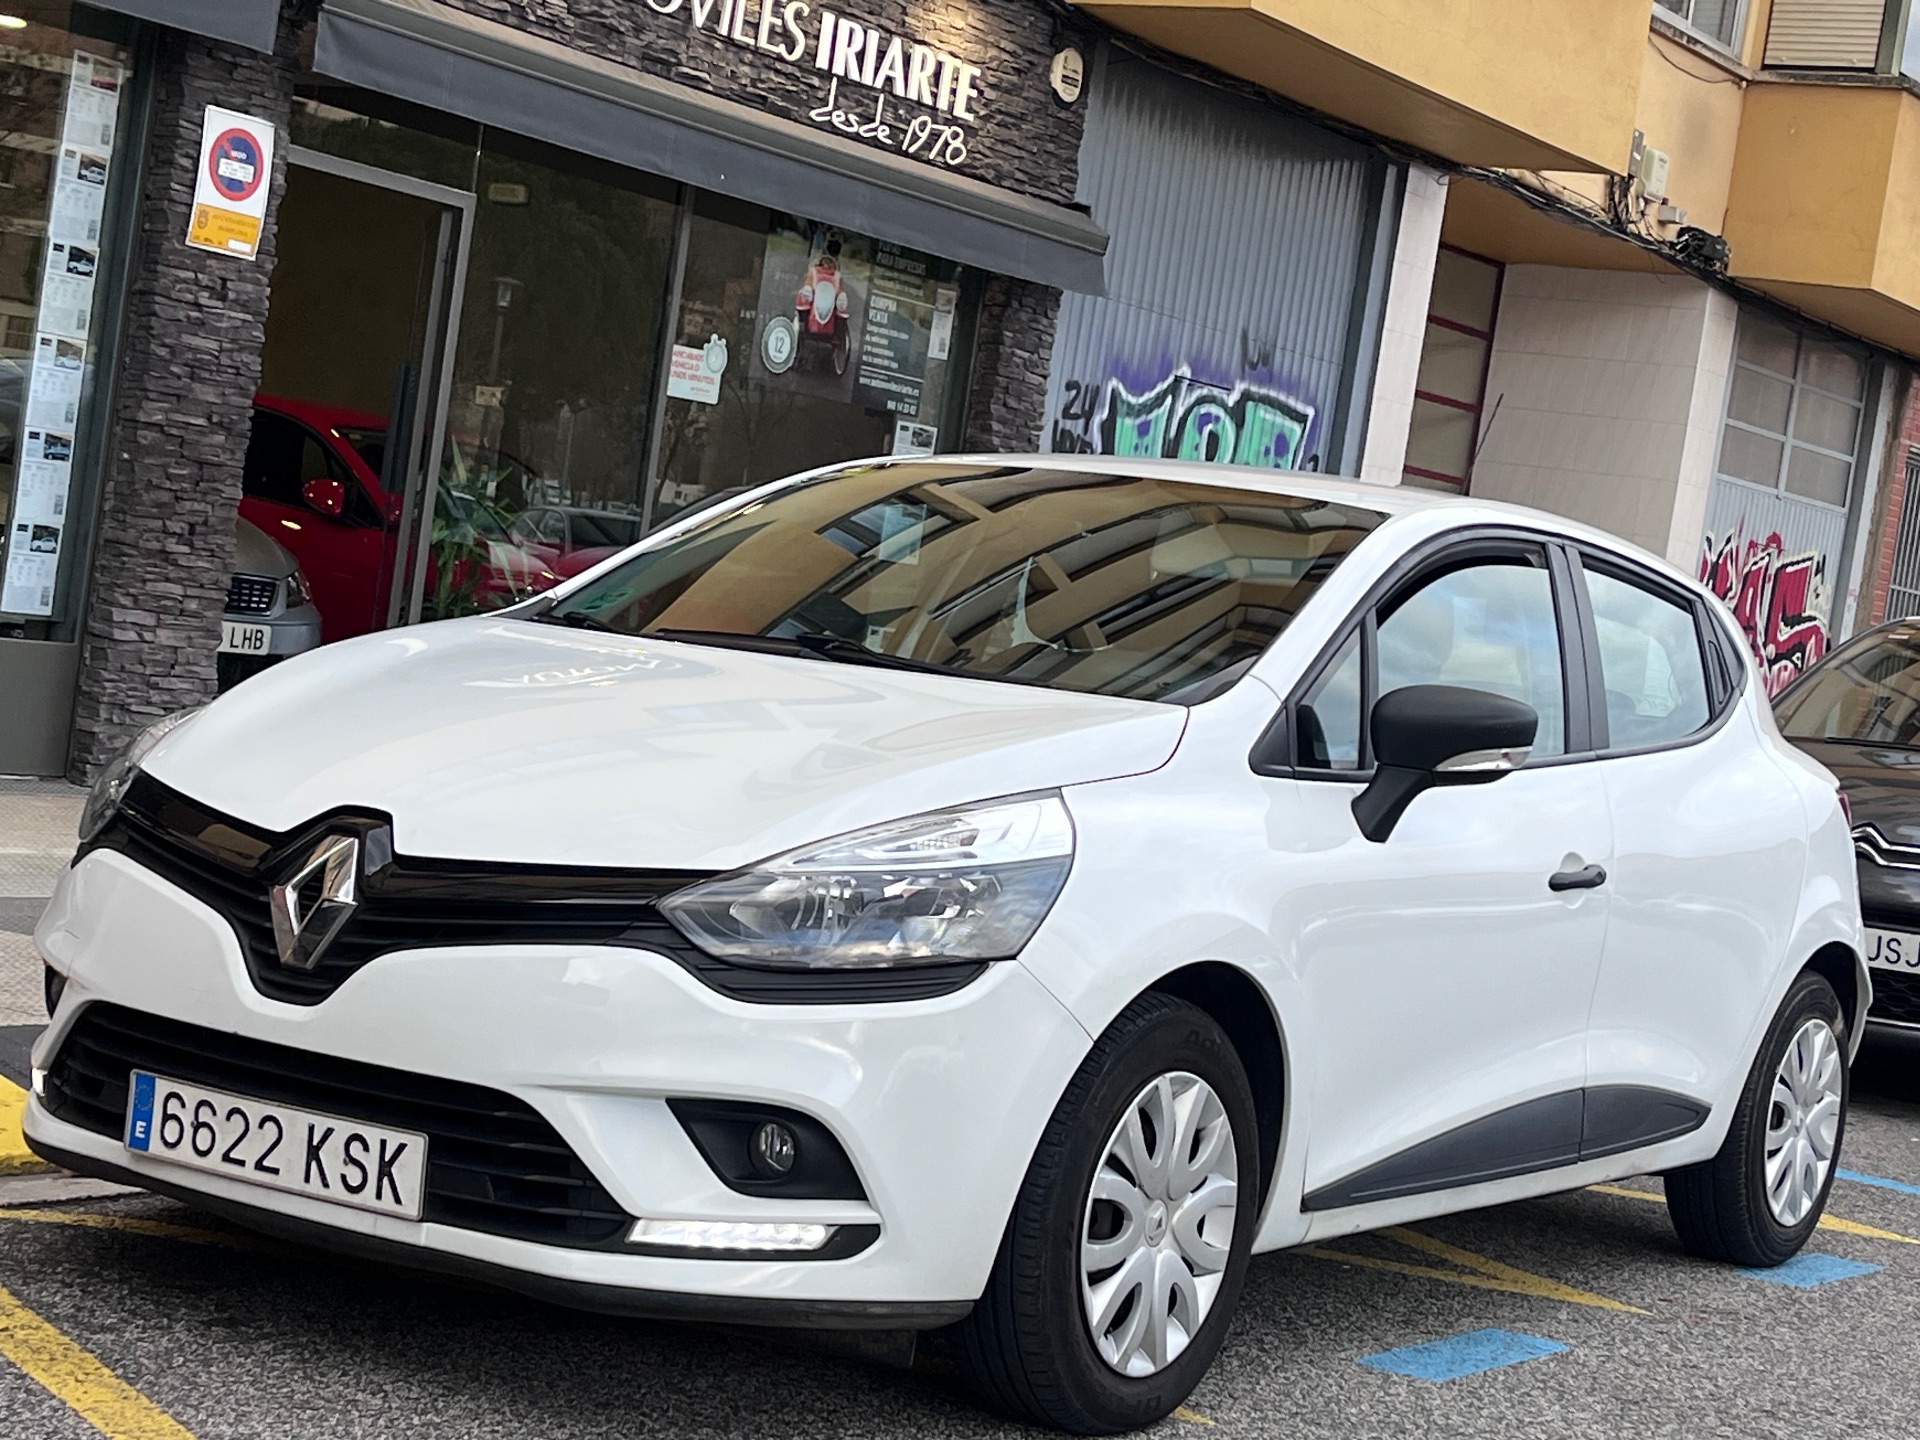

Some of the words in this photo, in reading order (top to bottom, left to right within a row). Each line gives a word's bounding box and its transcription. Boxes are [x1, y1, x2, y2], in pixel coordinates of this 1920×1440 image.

[648, 0, 811, 62] VILES
[815, 12, 982, 122] IRIARTE
[809, 76, 895, 145] desde
[902, 115, 967, 165] 1978
[774, 335, 785, 354] 12
[229, 626, 264, 650] LHB
[1868, 935, 1920, 968] JSJ
[134, 1120, 146, 1139] E
[160, 1091, 284, 1175] 6622
[303, 1122, 408, 1206] KSK
